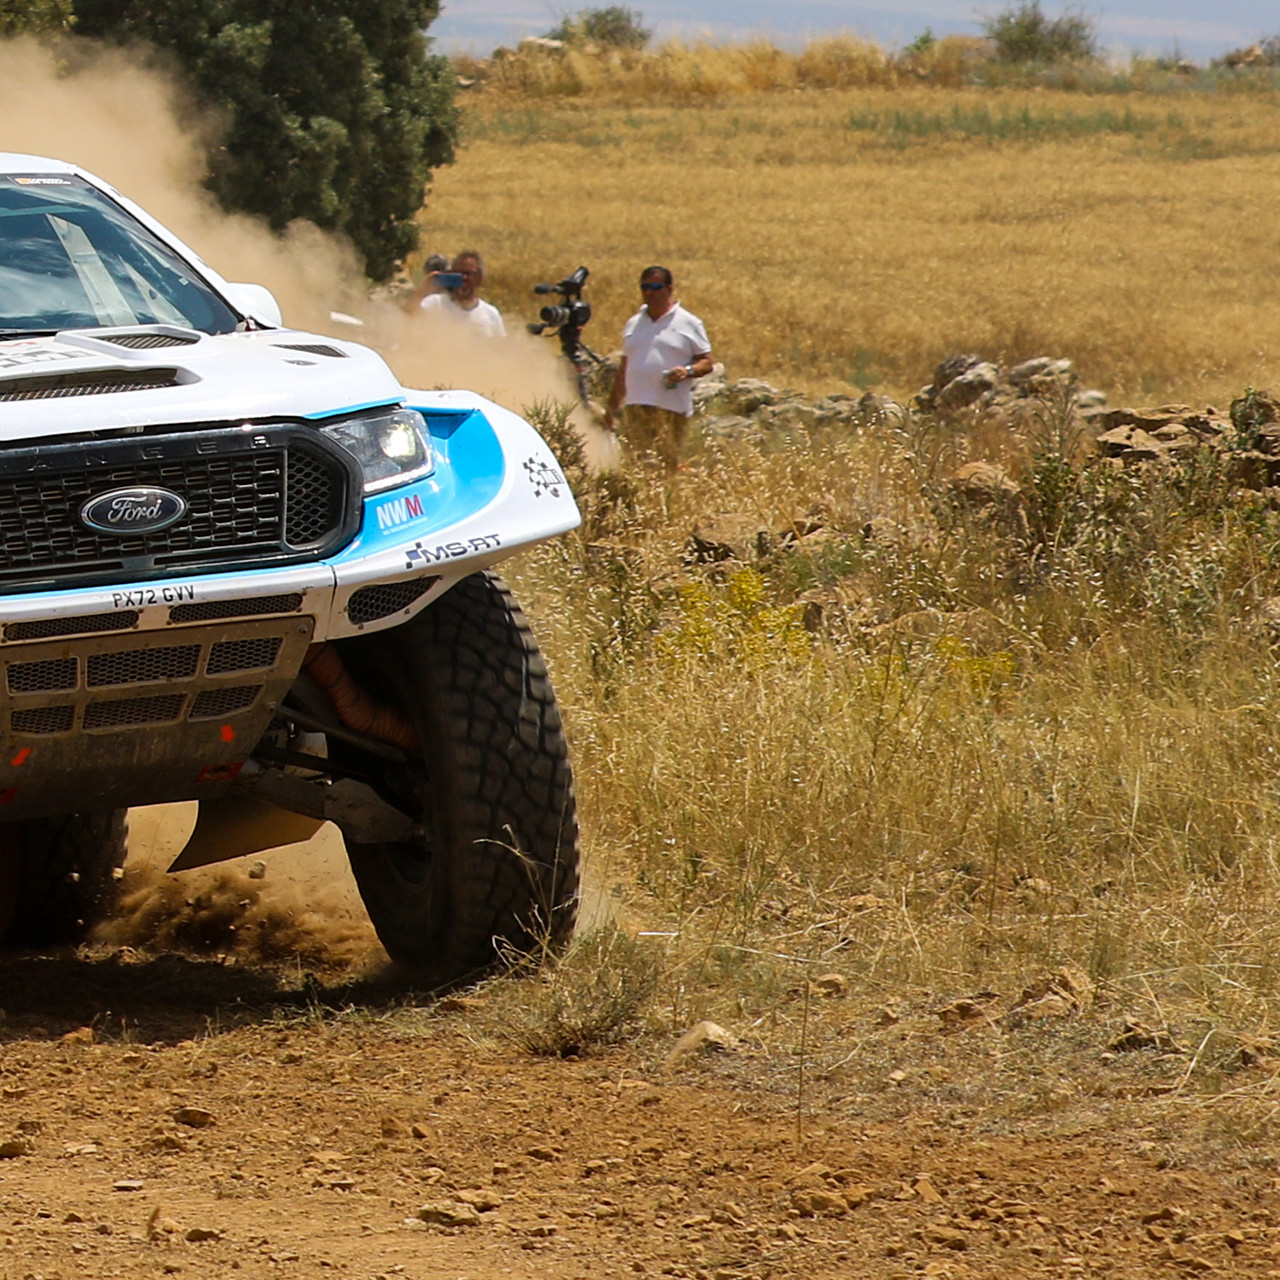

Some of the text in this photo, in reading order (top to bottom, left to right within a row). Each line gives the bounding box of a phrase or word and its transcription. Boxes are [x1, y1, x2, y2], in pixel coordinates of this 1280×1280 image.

[107, 496, 162, 522] Ford
[376, 494, 424, 529] NWM
[420, 533, 502, 563] MS-RT
[112, 585, 194, 608] PX72 GVV
